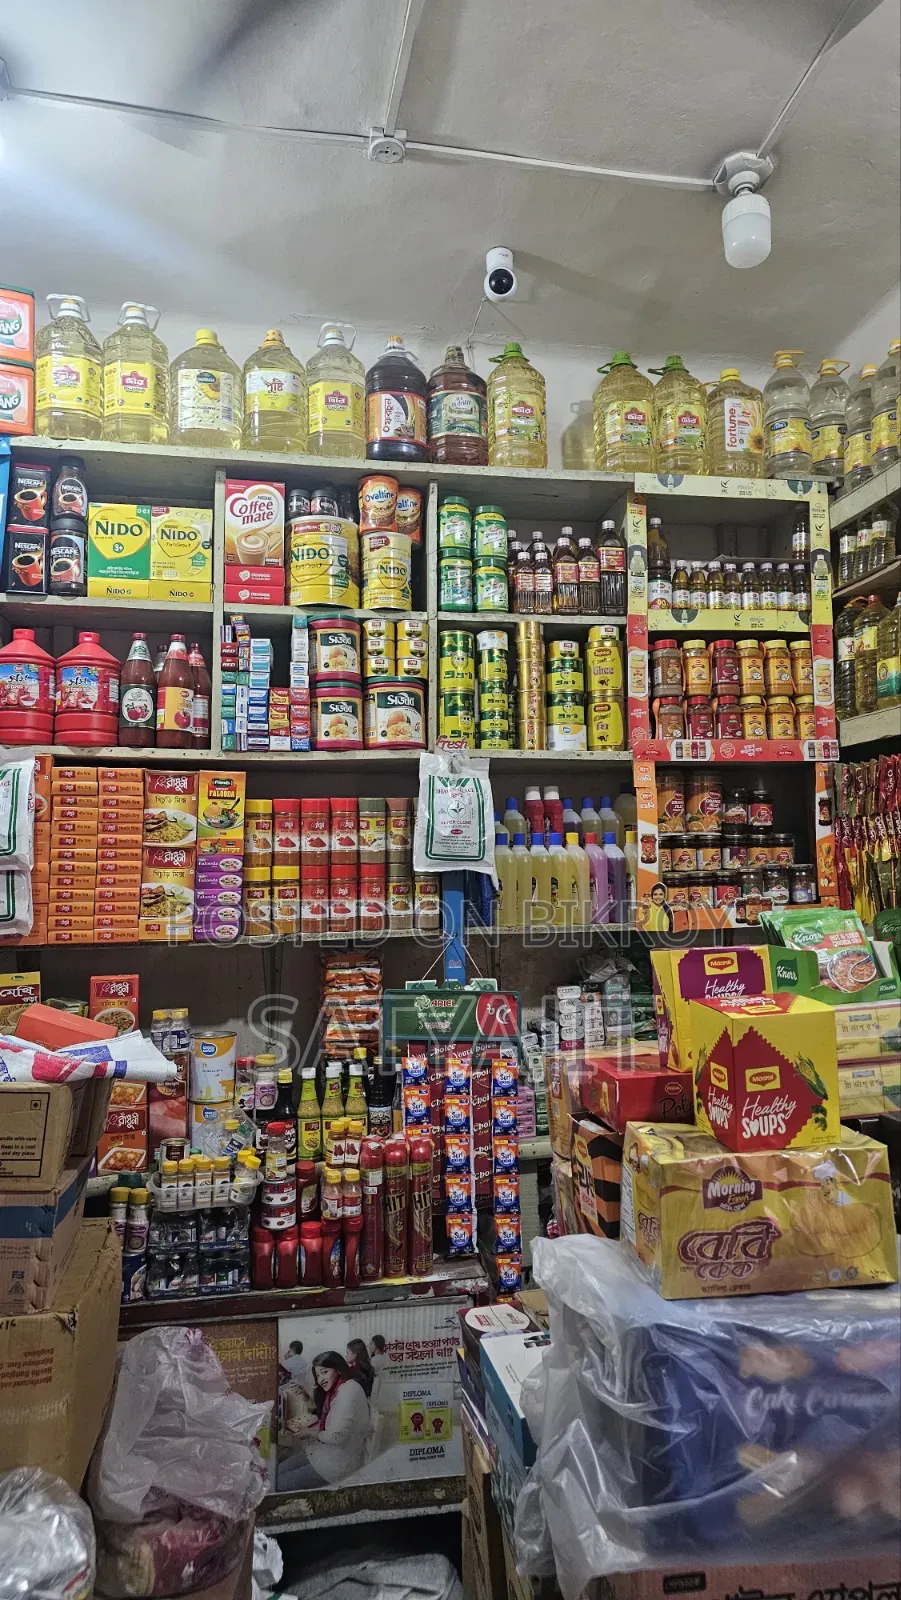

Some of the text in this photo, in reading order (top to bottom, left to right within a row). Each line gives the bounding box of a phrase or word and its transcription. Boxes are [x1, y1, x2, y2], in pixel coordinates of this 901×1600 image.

[0, 320, 20, 335] ANG
[0, 395, 20, 411] ANG
[727, 407, 737, 448] fortune
[365, 488, 395, 505] Ovaltine
[229, 497, 274, 518] Coffee
[396, 498, 419, 510] altine
[241, 511, 274, 525] mate
[95, 520, 143, 537] NIDO
[160, 528, 198, 541] NIDO
[114, 544, 123, 552] 3+
[289, 547, 330, 562] NIDO
[379, 564, 407, 575] NIDO
[106, 587, 126, 595] NIDO
[169, 589, 188, 597] NIDO
[209, 790, 235, 798] FALOODA
[881, 923, 901, 934] Kno
[792, 931, 824, 943] Knorr
[776, 965, 798, 981] Knorr
[705, 978, 746, 996] Healthy
[431, 999, 457, 1007] ARIEL
[453, 1070, 465, 1079] Surf
[500, 1074, 511, 1082] Surf
[411, 1102, 424, 1110] Surf
[708, 1085, 733, 1118] Healthy
[741, 1094, 798, 1121] Healthy
[451, 1111, 463, 1119] Surf
[451, 1151, 464, 1160] Surf
[500, 1151, 512, 1160] Surf
[707, 1178, 756, 1199] Morning
[451, 1192, 465, 1201] Surf
[501, 1191, 514, 1201] Surf
[454, 1231, 466, 1239] Surf
[503, 1231, 515, 1239] Surf
[504, 1271, 515, 1279] Surf
[403, 1389, 432, 1398] DIPLOMA
[409, 1445, 446, 1457] DIPLOMA
